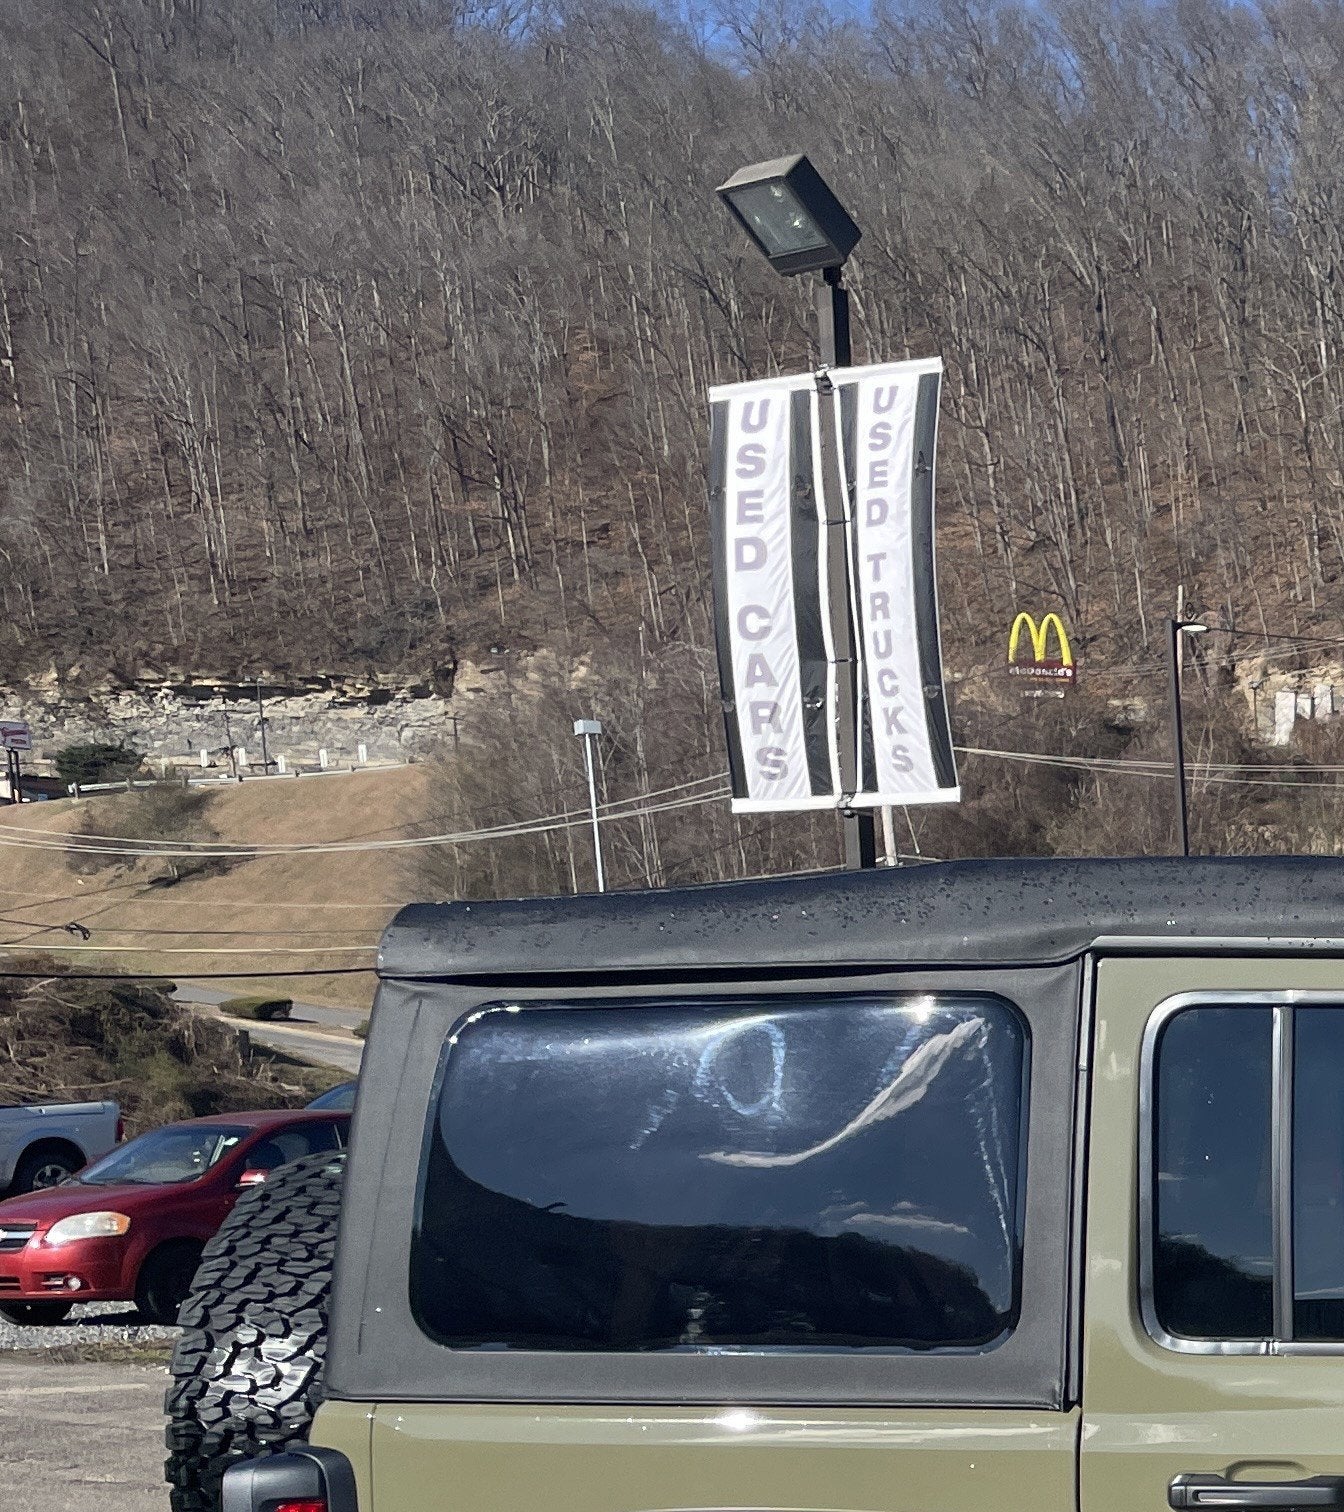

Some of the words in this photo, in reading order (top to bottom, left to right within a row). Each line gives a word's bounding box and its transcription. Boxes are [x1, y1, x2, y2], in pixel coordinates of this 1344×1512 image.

[733, 398, 770, 572] USED
[866, 385, 897, 528] USED
[737, 604, 789, 781] CARS
[867, 552, 915, 774] TRUCKS
